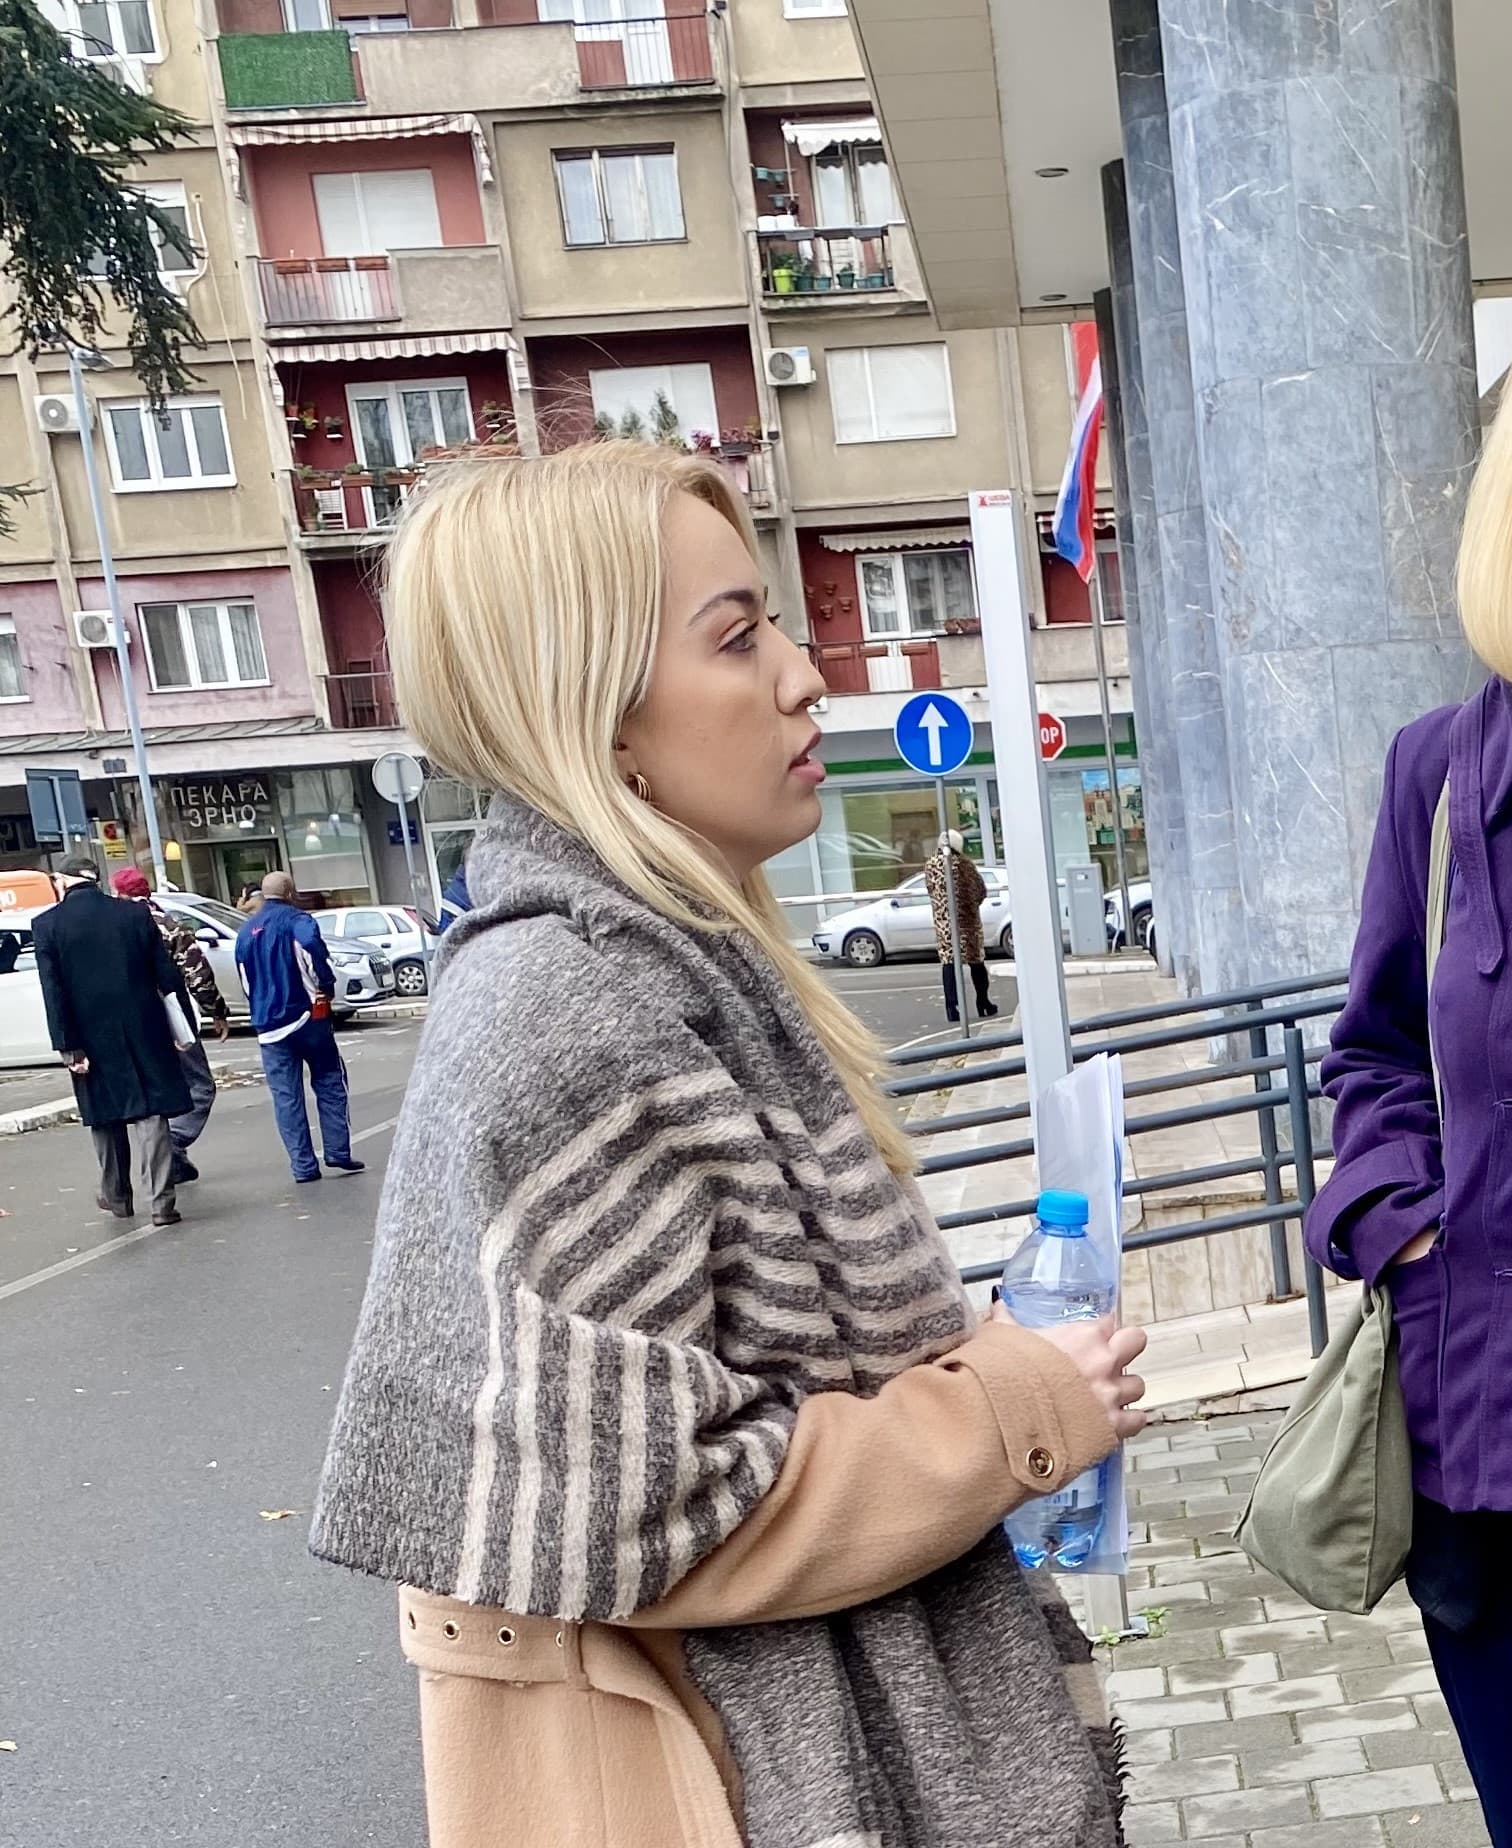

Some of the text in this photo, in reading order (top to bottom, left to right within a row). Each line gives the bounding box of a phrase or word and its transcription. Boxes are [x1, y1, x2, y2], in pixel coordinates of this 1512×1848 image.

[1040, 727, 1060, 744] OP
[170, 782, 268, 807] ПЕКАРА
[189, 804, 257, 828] ЗРНО
